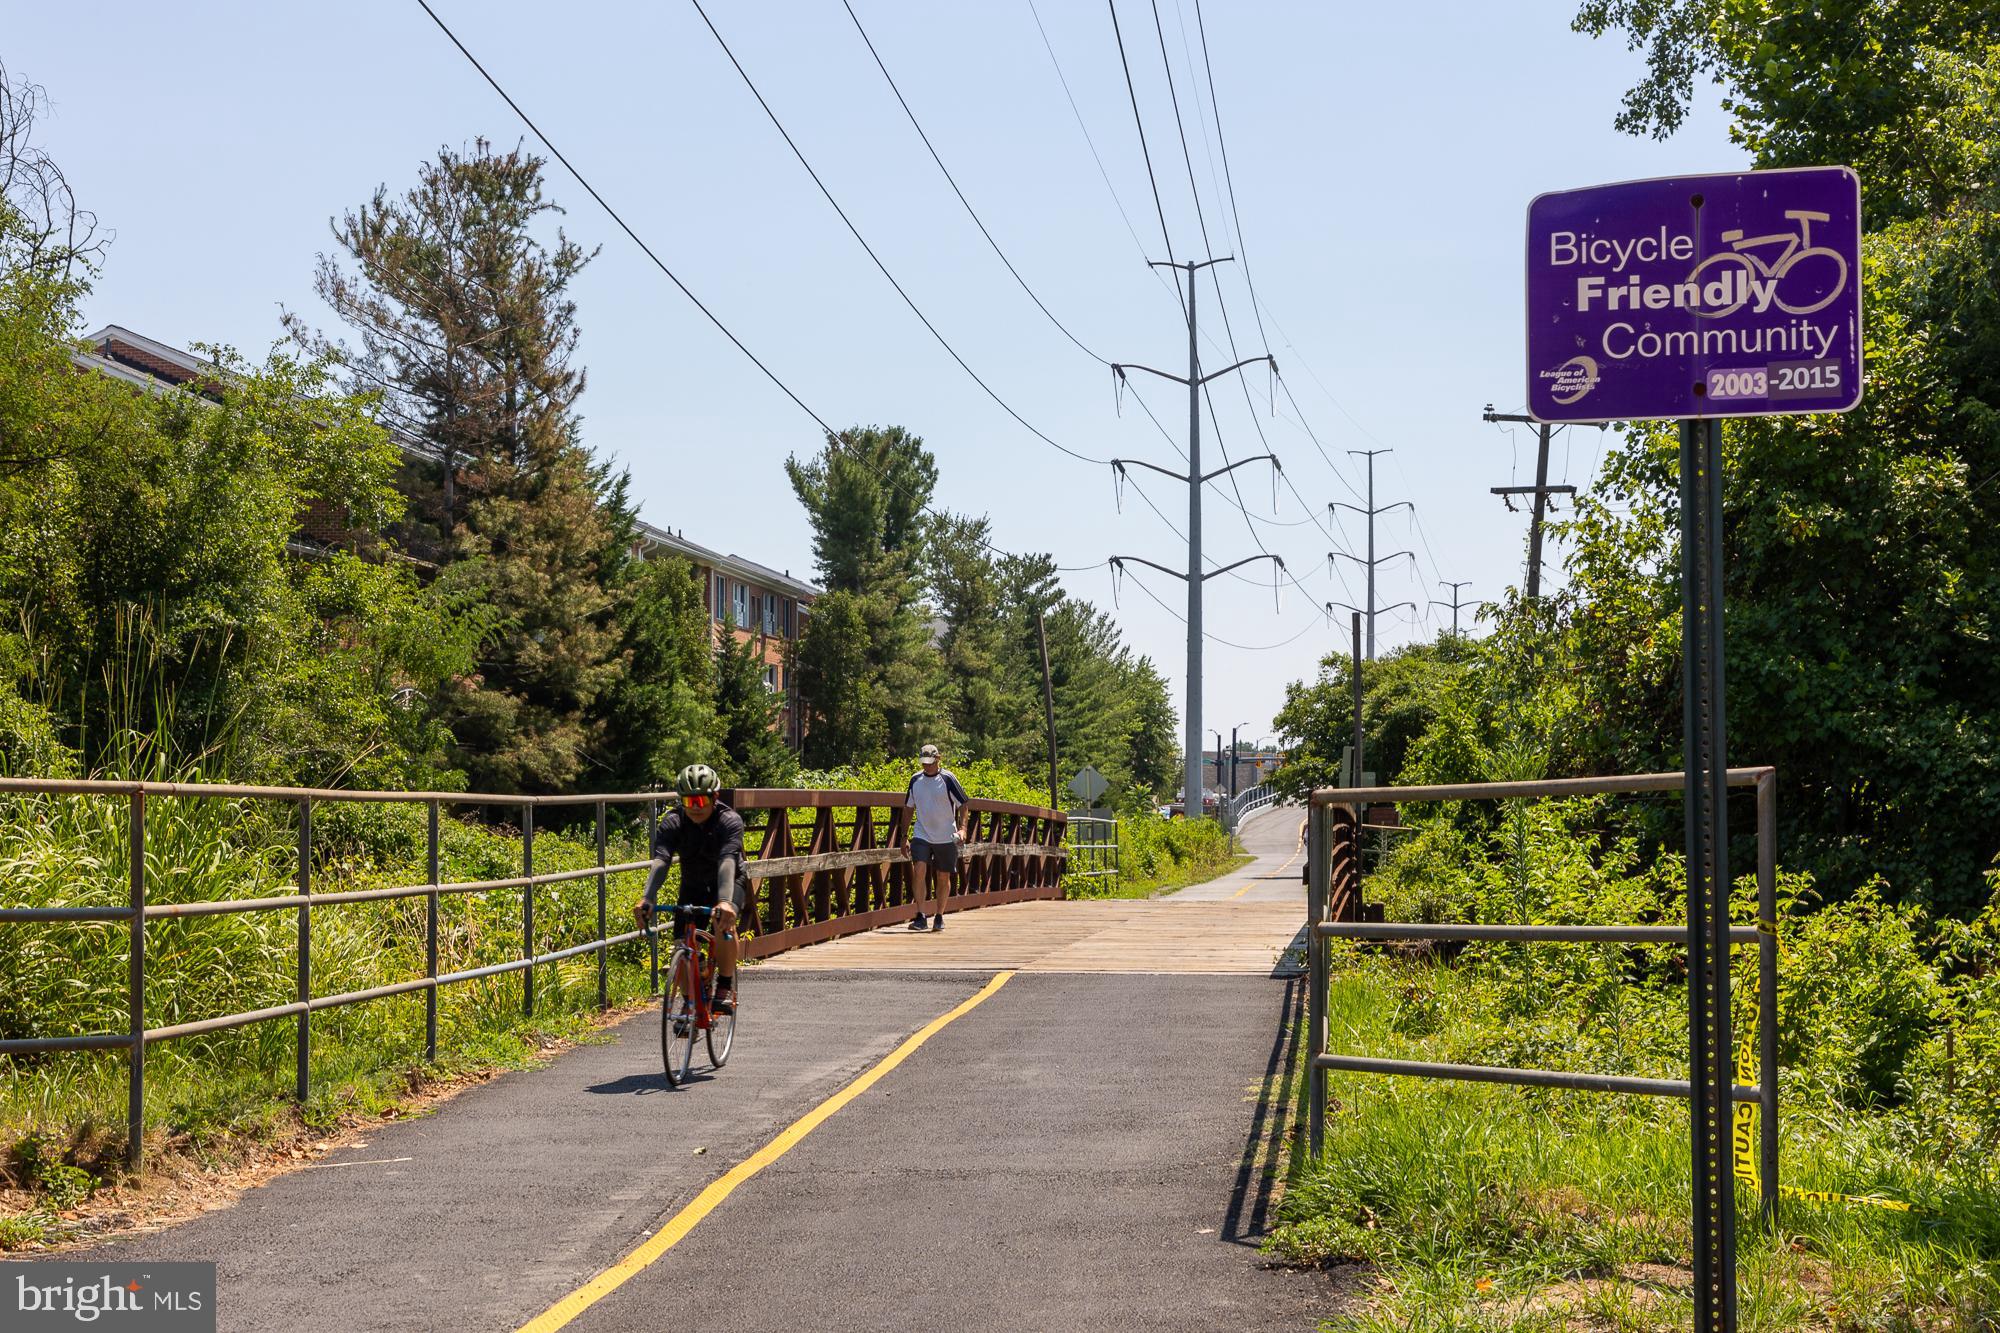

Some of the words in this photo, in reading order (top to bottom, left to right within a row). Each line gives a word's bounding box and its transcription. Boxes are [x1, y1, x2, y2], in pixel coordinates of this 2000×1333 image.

[1551, 226, 1694, 272] Bicycle
[1577, 270, 1778, 313] Friendly
[1602, 319, 1839, 359] Community
[1539, 370, 1572, 378] League
[1551, 384, 1595, 392] Bicyclists
[1557, 376, 1601, 384] American
[1711, 365, 1840, 397] 2003-2015
